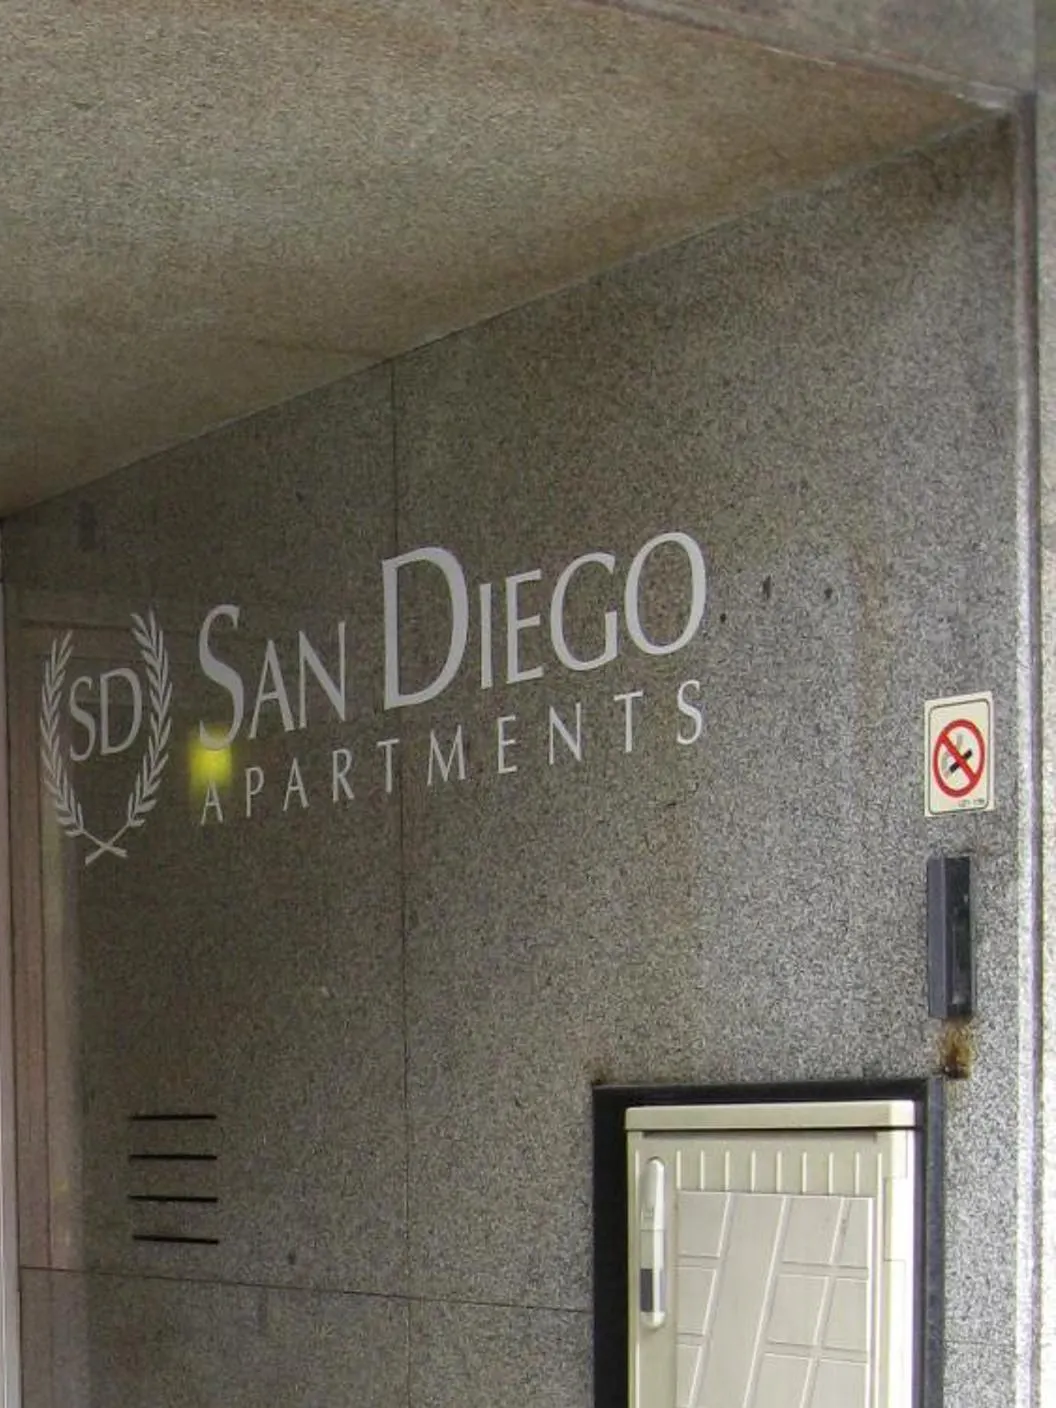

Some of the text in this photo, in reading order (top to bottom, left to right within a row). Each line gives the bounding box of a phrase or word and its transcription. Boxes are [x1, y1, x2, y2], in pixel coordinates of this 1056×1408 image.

[68, 667, 143, 761] SD
[199, 531, 707, 750] SAN DIEGO
[200, 679, 704, 826] APARTMENTS
